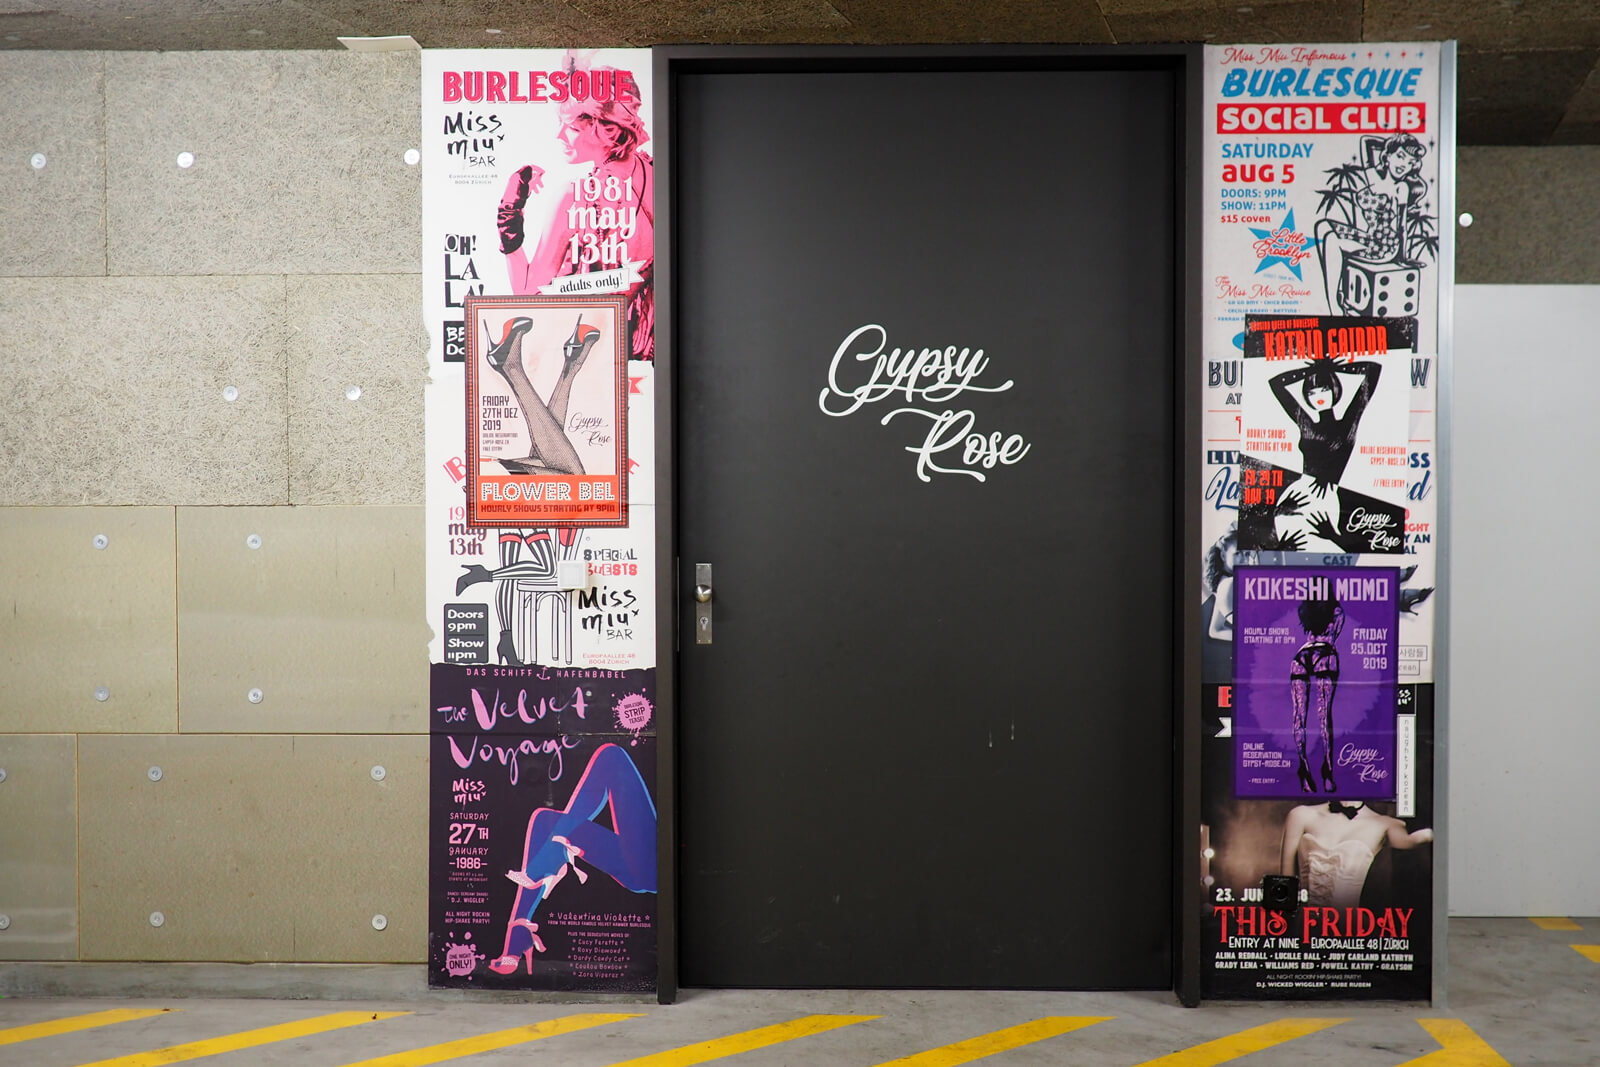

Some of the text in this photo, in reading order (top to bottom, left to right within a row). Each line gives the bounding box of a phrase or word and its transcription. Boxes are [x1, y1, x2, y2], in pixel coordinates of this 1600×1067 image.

[1220, 46, 1347, 66] Miss Miu Infamous
[443, 70, 634, 104] BURLESQUE
[1221, 67, 1423, 100] BURLESQUE
[444, 111, 502, 136] Miss
[1340, 105, 1421, 131] CLUB
[1221, 143, 1314, 158] SATURDAY
[469, 155, 496, 167] BAR
[1281, 164, 1295, 184] 5
[571, 176, 633, 201] 1981
[1221, 189, 1286, 198] DOORS: 9PM
[1221, 201, 1286, 210] SHOW: 11PM
[567, 205, 637, 238] may
[1221, 214, 1271, 224] $15 cover
[445, 234, 477, 255] OH!
[1271, 228, 1306, 247] Little
[569, 233, 632, 265] 13th
[1252, 239, 1311, 266] Brooklyn
[445, 253, 480, 280] LA
[560, 272, 624, 294] adults only!
[1217, 284, 1247, 299] Miss
[1264, 329, 1325, 361] KATRIN
[819, 324, 1014, 417] Gypsy
[483, 396, 509, 406] FRIDAY
[483, 407, 518, 419] 27TH DEZ
[483, 420, 501, 431] 2019
[568, 412, 608, 433] Gypsy
[581, 430, 612, 447] Rose
[1246, 429, 1286, 439] HOURLY SHOWS
[881, 408, 1031, 483] Rose
[1246, 441, 1271, 452] STARTING
[1273, 442, 1280, 452] AT
[481, 482, 615, 501] FLOWER BEL
[1265, 488, 1276, 505] 19
[481, 504, 615, 513] HOURLY SHOWS STARTING AT 9PM
[1346, 507, 1397, 532] Gypsy
[449, 538, 484, 556] 13th
[1362, 529, 1400, 550] Rose
[1323, 556, 1352, 566] CAST
[1245, 577, 1388, 601] KOKESHI MOMO
[578, 586, 637, 611] Miss
[448, 609, 484, 620] Doors
[448, 622, 476, 633] 9pm
[607, 629, 633, 640] BAR
[1353, 628, 1388, 640] FRIDAY
[448, 638, 484, 649] Show
[1244, 636, 1273, 644] STARTING
[1351, 643, 1388, 655] 25.OCT
[1363, 657, 1388, 670] 2019
[466, 668, 626, 679] DAS SCHIFF HAFENBABEL
[471, 686, 588, 731] Velvet
[624, 706, 645, 719] STRIP
[447, 734, 582, 785] Voyage
[1337, 743, 1384, 766] Gypsy
[1352, 763, 1389, 782] Rose
[452, 778, 485, 793] Miss
[449, 812, 490, 821] SATURDAY
[449, 823, 489, 844] 27TH
[1215, 888, 1235, 902] 23.
[1214, 906, 1414, 944] THIS FRIDAY
[1229, 936, 1262, 949] ENTRY
[1264, 937, 1276, 949] AT
[1278, 938, 1300, 949] NINE
[1311, 937, 1365, 950] EUROPAALLEE
[1366, 939, 1379, 949] 48
[449, 960, 472, 970] ONLY!
